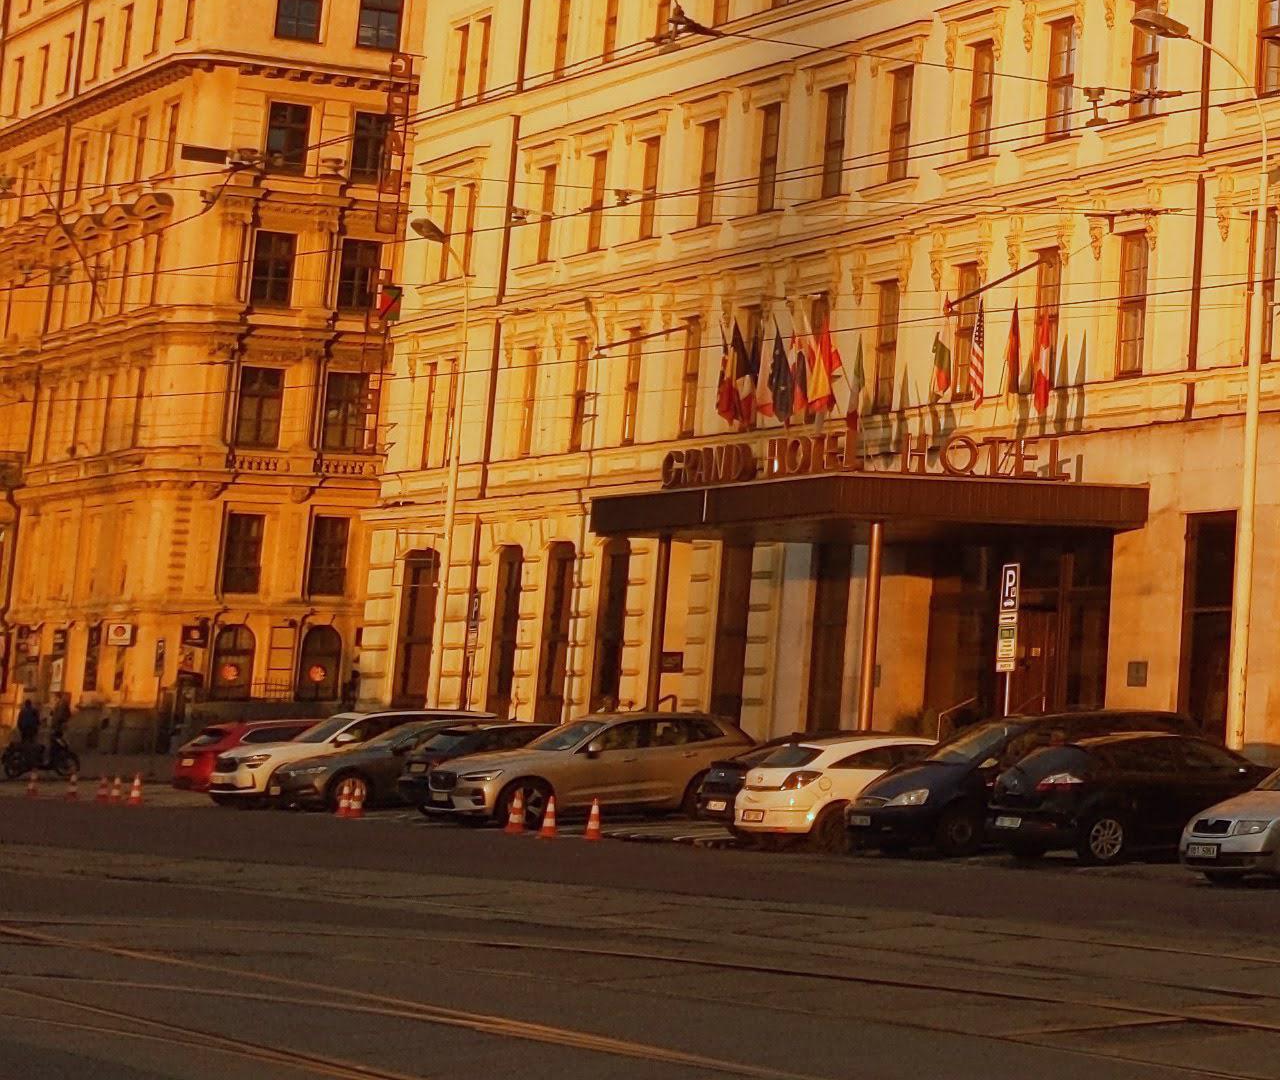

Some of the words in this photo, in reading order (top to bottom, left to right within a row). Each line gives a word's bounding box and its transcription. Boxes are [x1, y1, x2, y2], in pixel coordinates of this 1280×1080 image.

[662, 443, 757, 488] GRAND
[767, 430, 865, 474] HOTEL
[900, 433, 1071, 481] HOTEL
[1004, 570, 1016, 597] P
